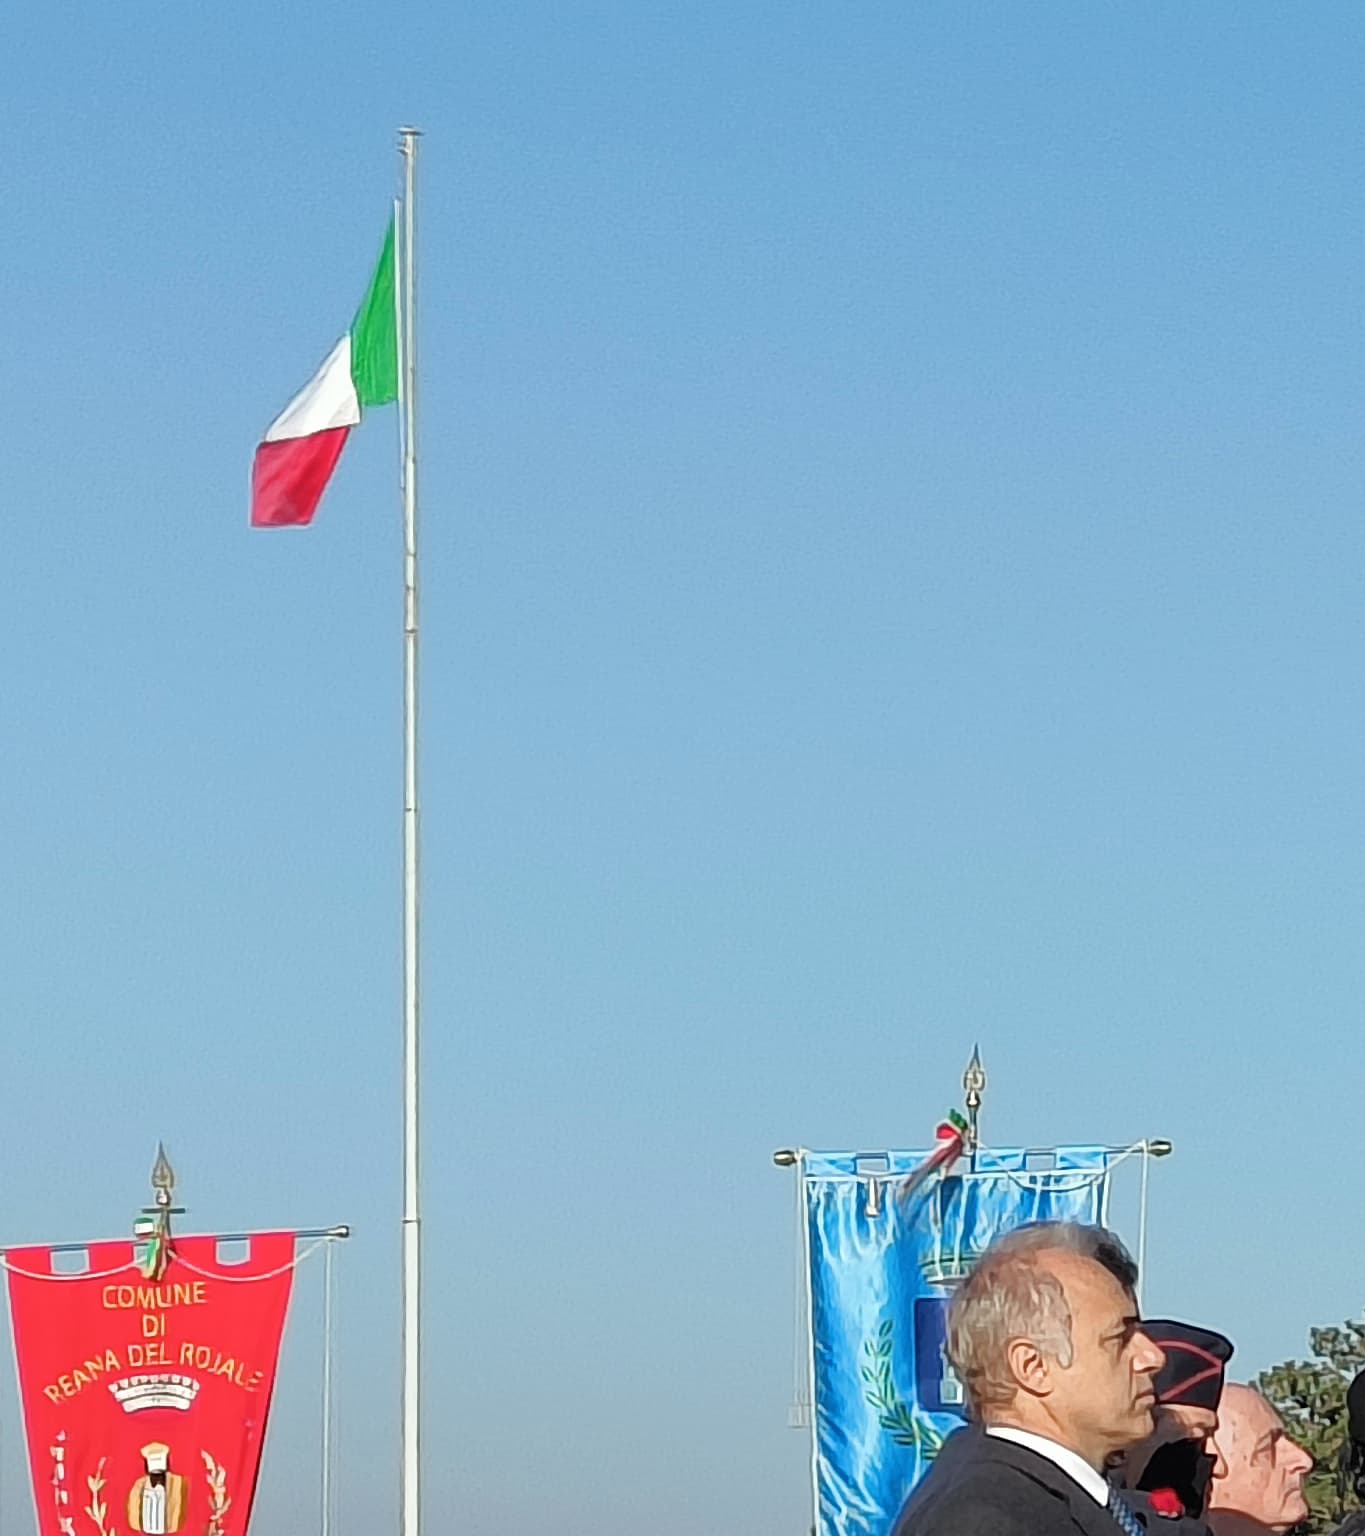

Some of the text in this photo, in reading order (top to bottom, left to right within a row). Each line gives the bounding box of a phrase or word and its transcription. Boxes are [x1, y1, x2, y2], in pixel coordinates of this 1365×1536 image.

[102, 1281, 207, 1310] COMUNE
[142, 1313, 165, 1338] DI
[44, 1340, 265, 1405] REANA DEL ROJALE
